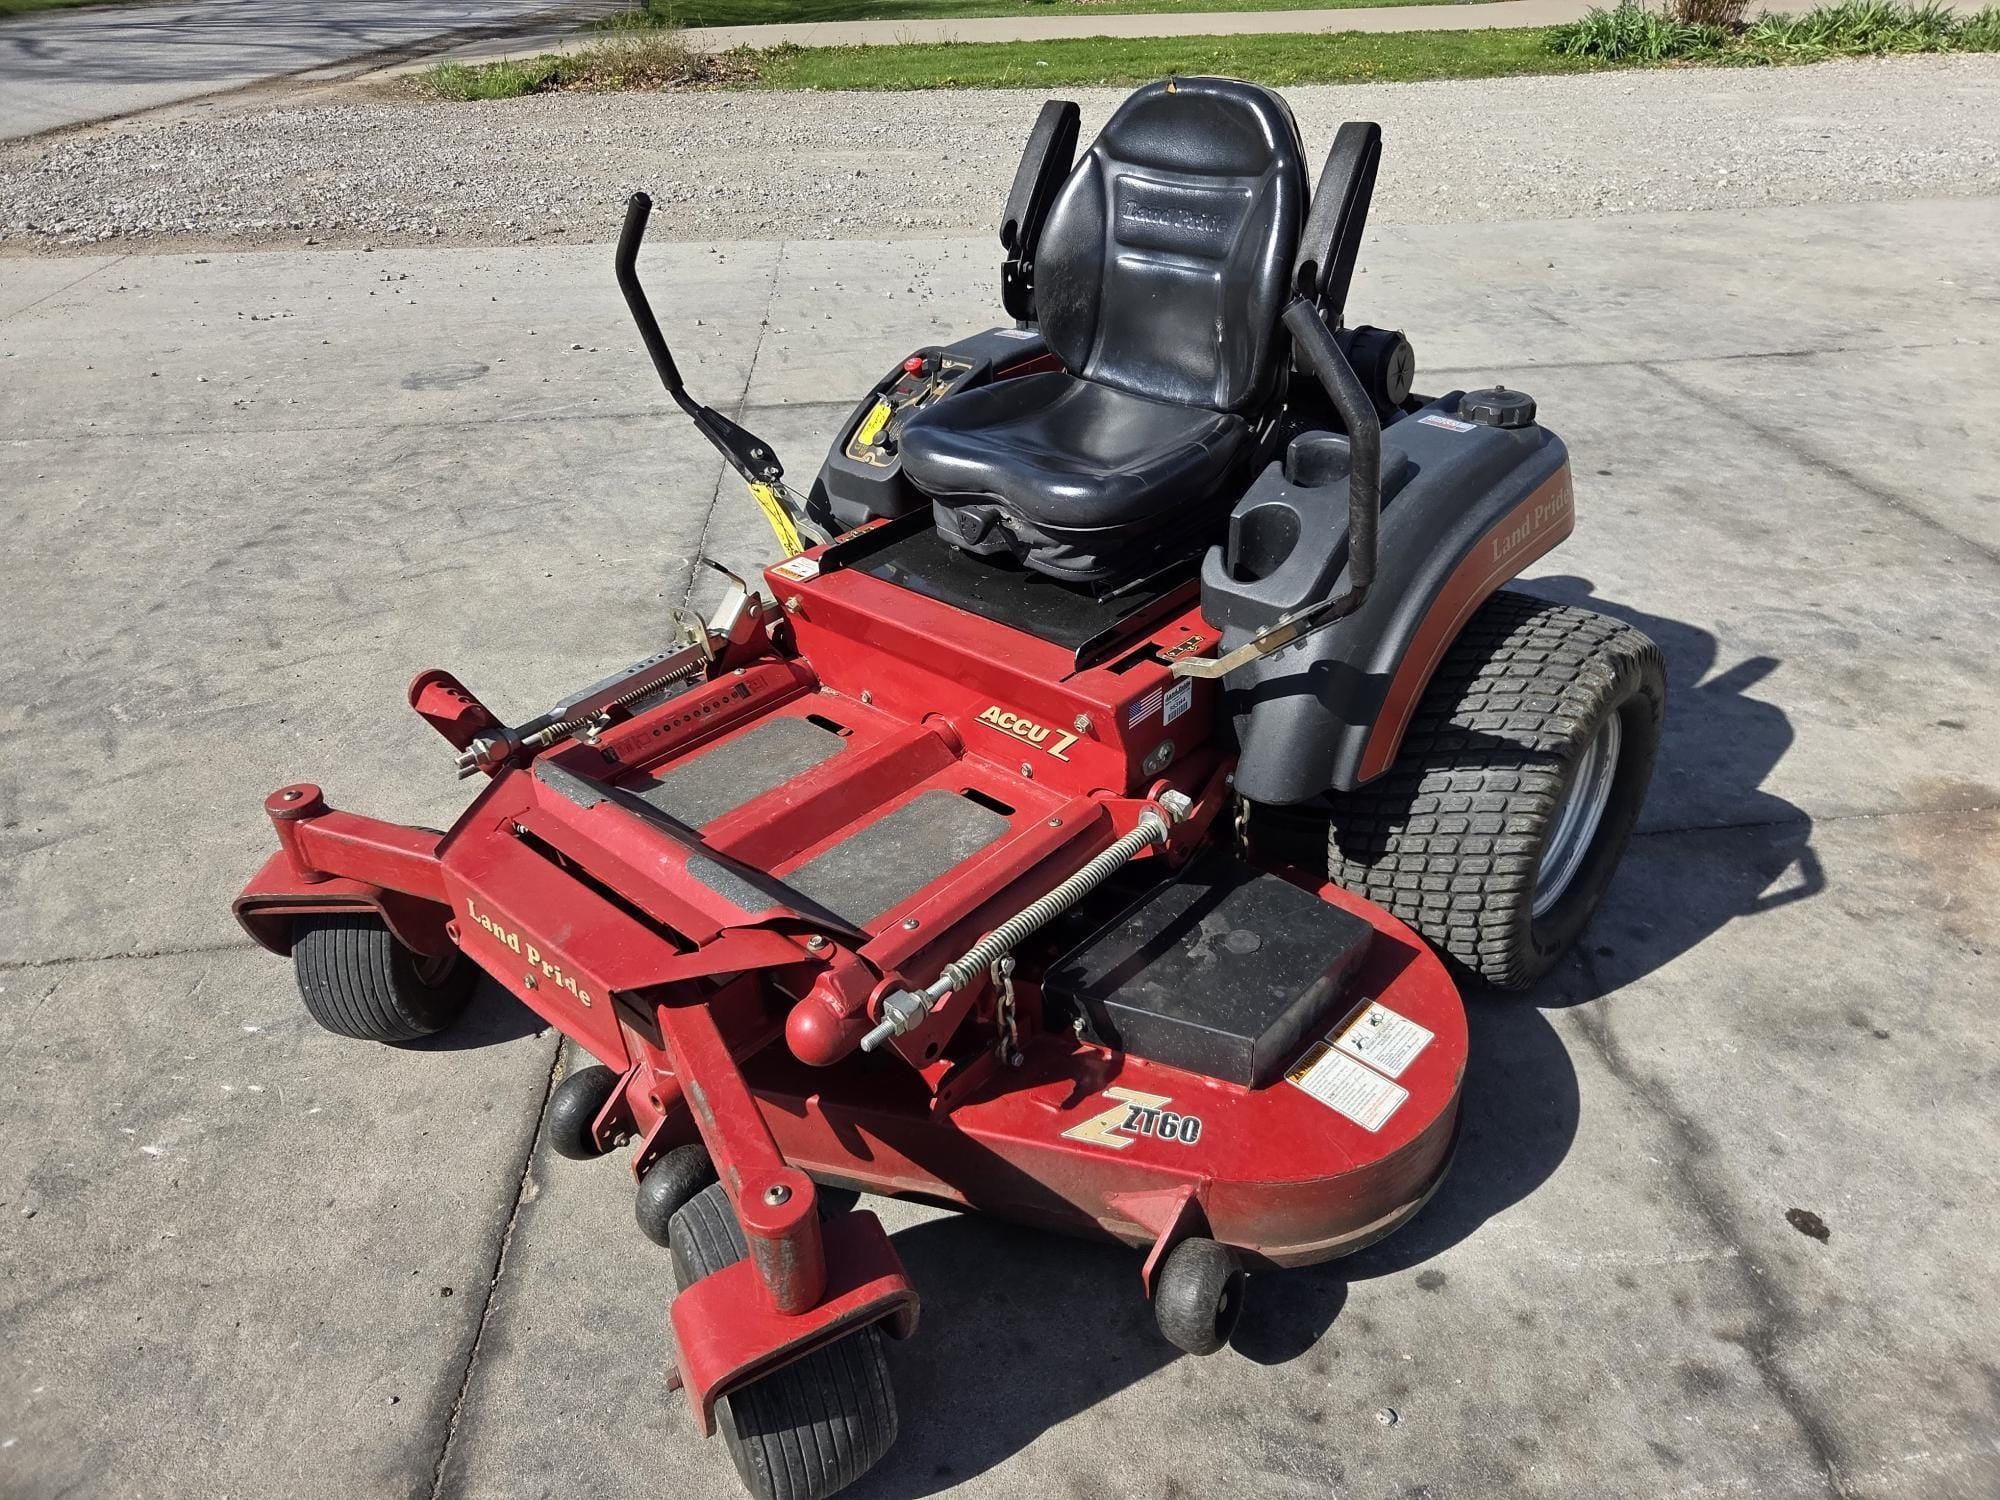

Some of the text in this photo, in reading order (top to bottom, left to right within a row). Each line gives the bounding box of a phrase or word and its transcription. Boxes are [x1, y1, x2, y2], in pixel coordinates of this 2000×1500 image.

[1122, 200, 1228, 233] Land Pride
[1491, 487, 1569, 563] Land Pride
[979, 705, 1080, 762] ACCU Z
[466, 897, 592, 1007] Land Pride
[1120, 1103, 1202, 1144] ZT60
